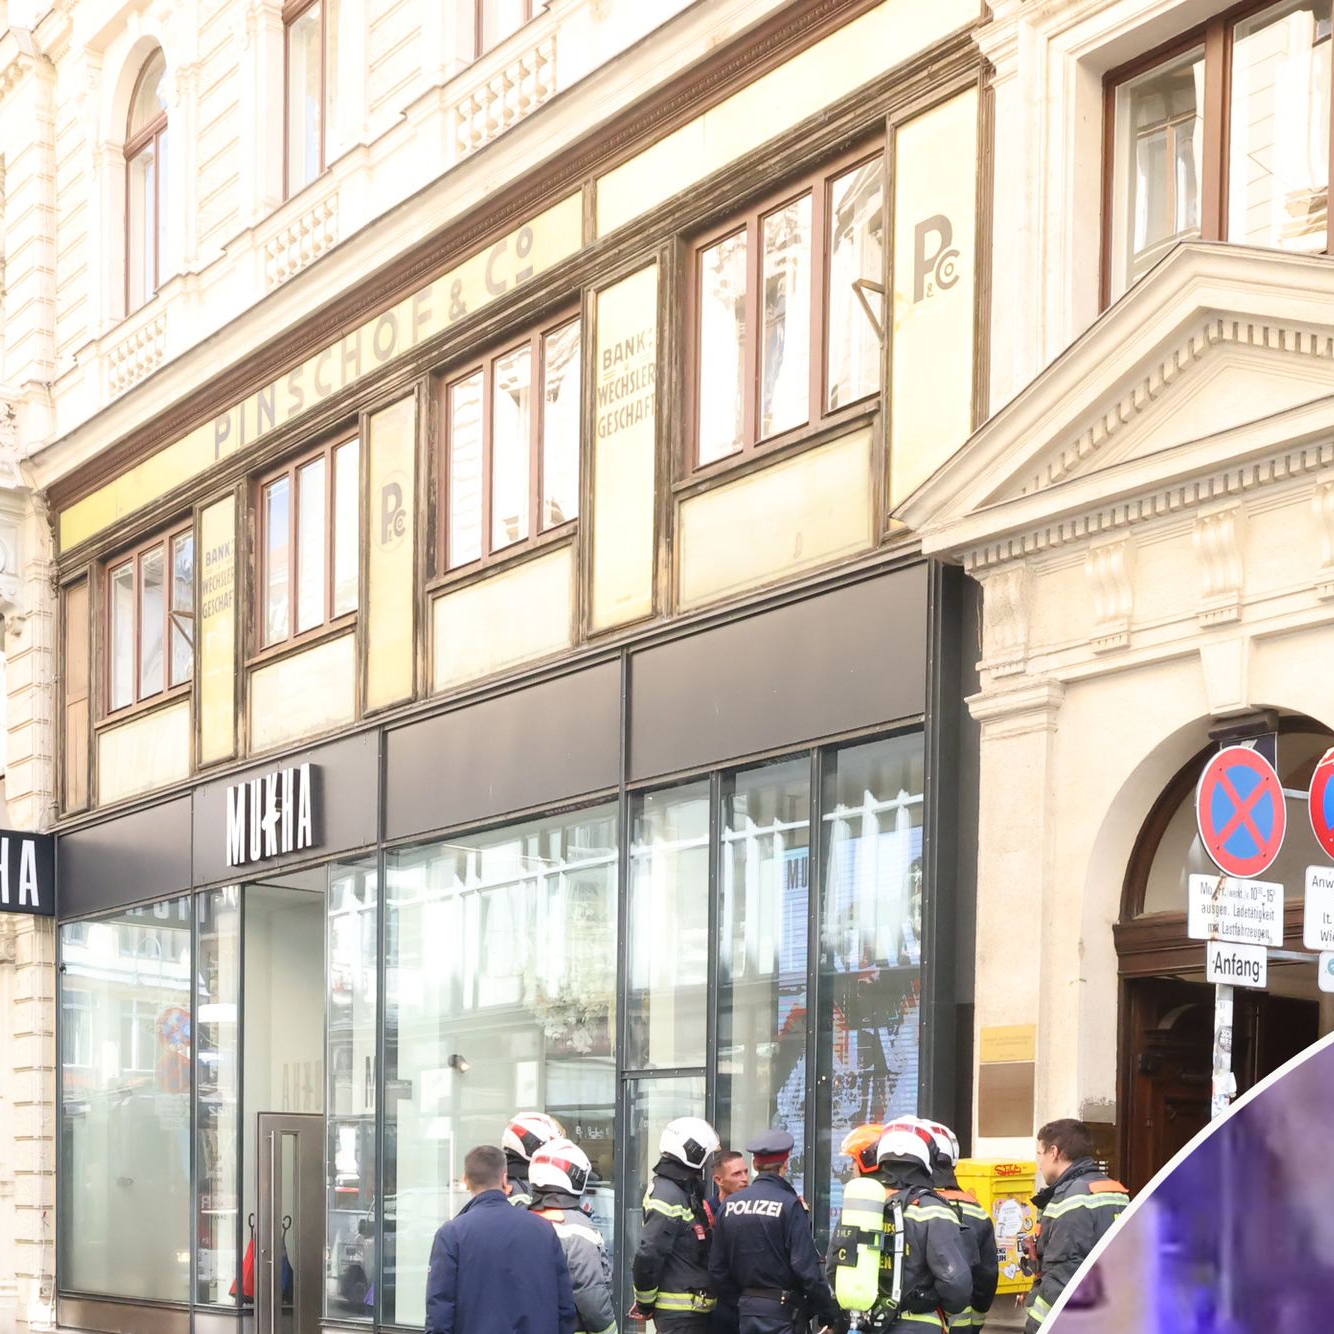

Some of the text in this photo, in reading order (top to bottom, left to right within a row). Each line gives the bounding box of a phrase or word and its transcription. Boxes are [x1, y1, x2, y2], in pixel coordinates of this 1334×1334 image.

[214, 287, 433, 460] PINSCHOF
[448, 278, 468, 322] &
[227, 763, 313, 867] MUKHA
[1214, 951, 1260, 983] Anfang
[725, 1200, 783, 1217] POLIZEI
[838, 1248, 847, 1261] C
